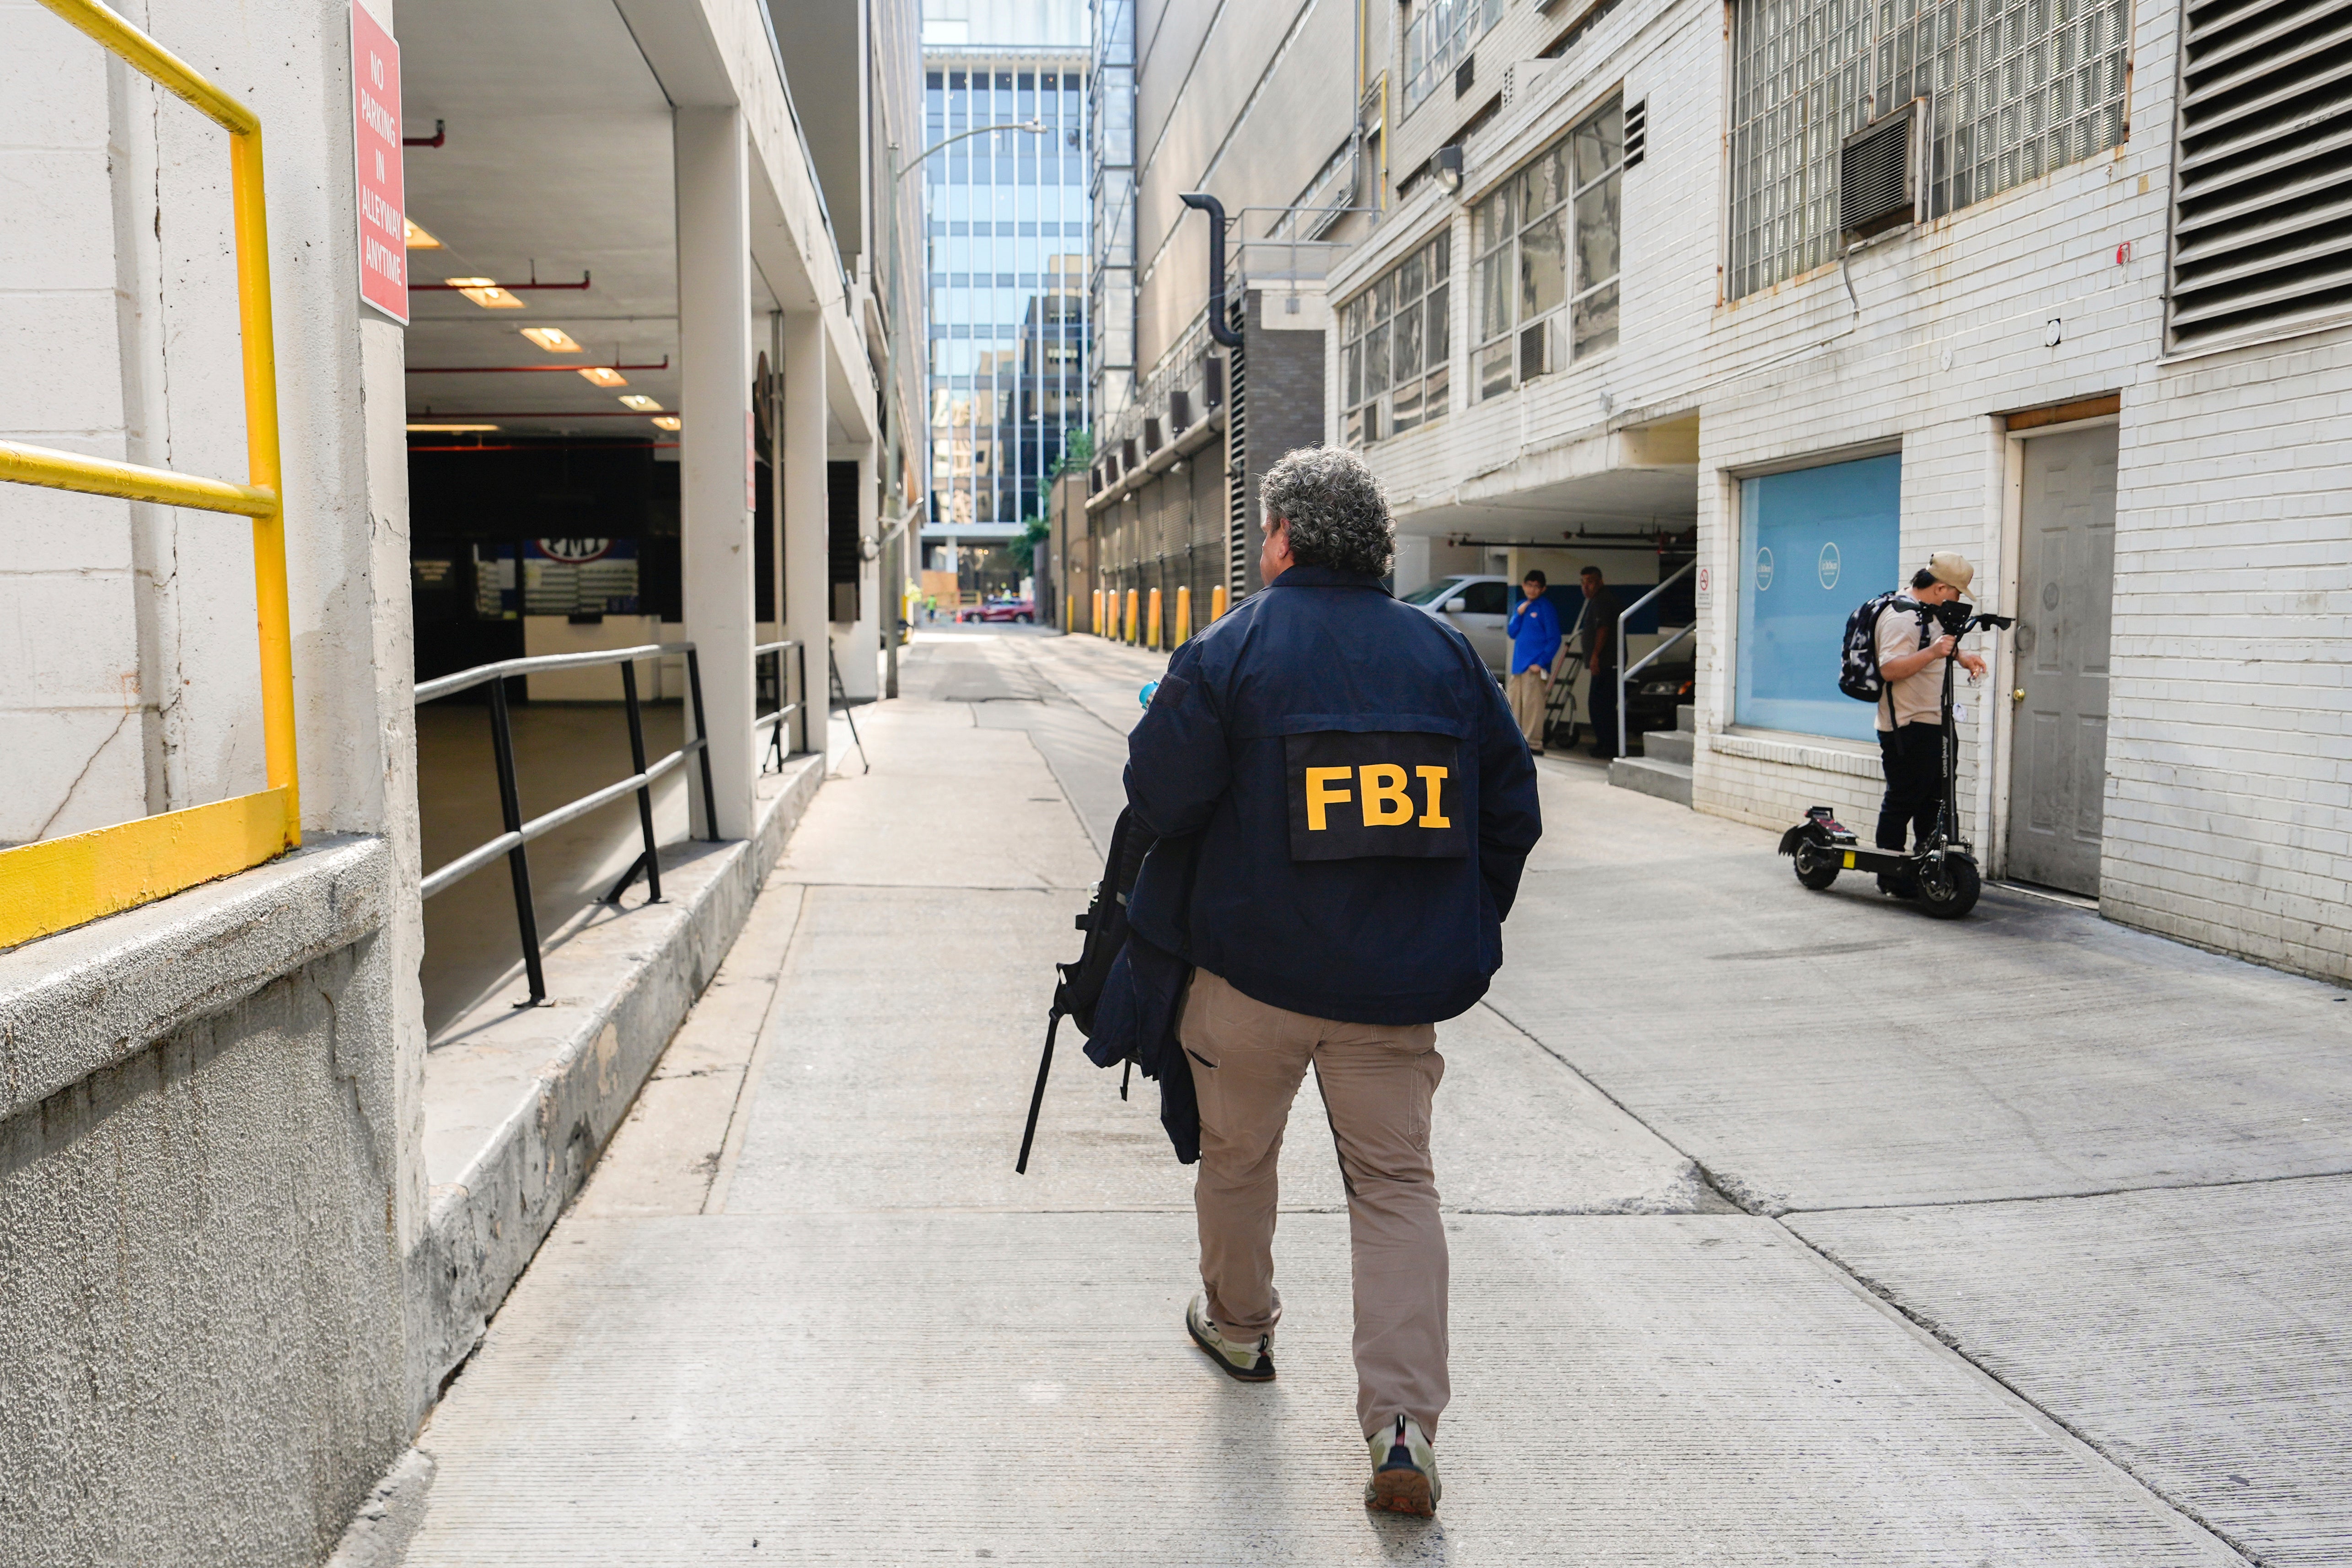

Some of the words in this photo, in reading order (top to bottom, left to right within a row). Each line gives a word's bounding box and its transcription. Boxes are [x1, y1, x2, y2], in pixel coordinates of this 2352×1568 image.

[370, 49, 384, 91] NO
[361, 87, 396, 148] PARKING
[376, 148, 385, 184] IN
[362, 184, 402, 242] ALLEYWAY
[366, 235, 402, 287] ANYTIME
[1305, 763, 1451, 831] FBI
